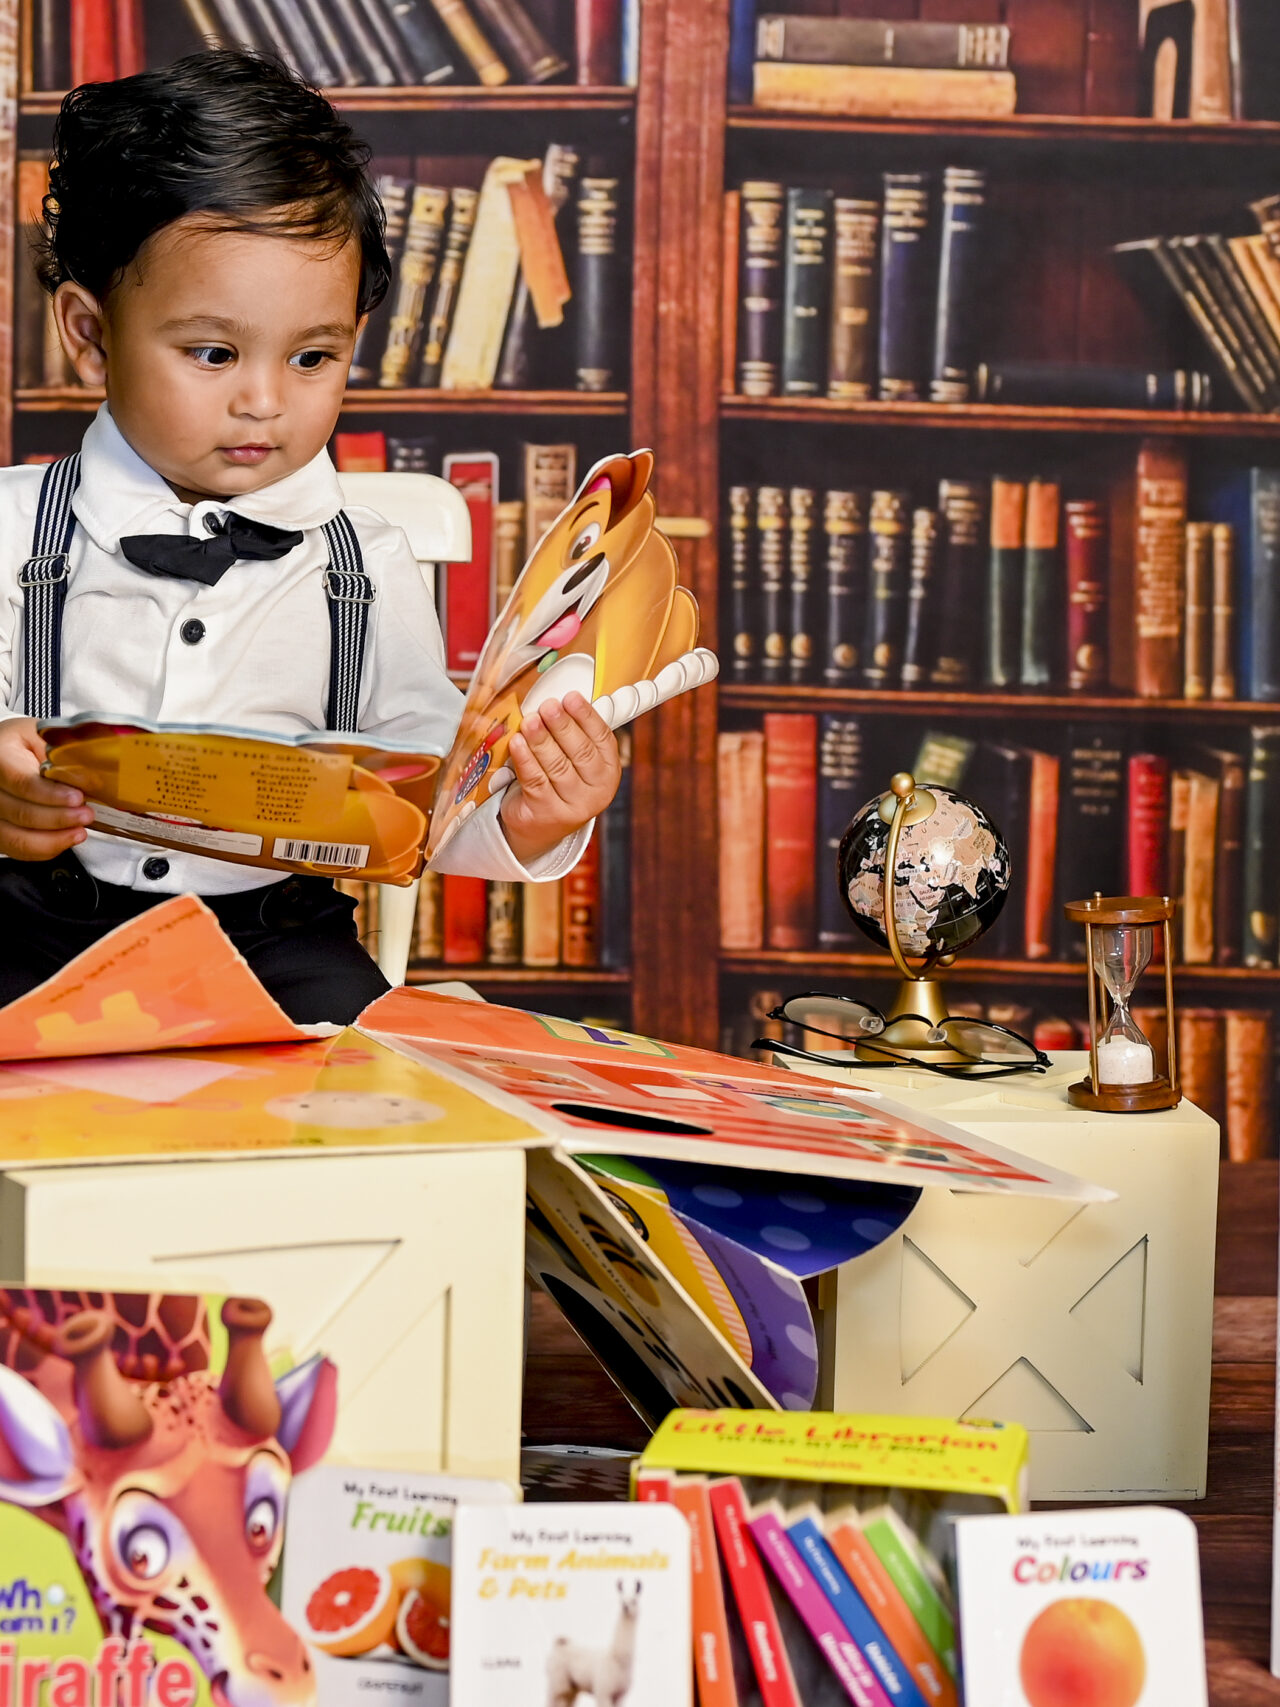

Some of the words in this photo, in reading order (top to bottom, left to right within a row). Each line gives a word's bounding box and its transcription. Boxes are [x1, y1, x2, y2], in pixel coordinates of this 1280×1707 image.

[350, 1502, 453, 1539] Fruits
[478, 1548, 551, 1570] Farm
[557, 1547, 670, 1571] Animals
[1012, 1553, 1151, 1586] Colours
[507, 1576, 568, 1600] Pets
